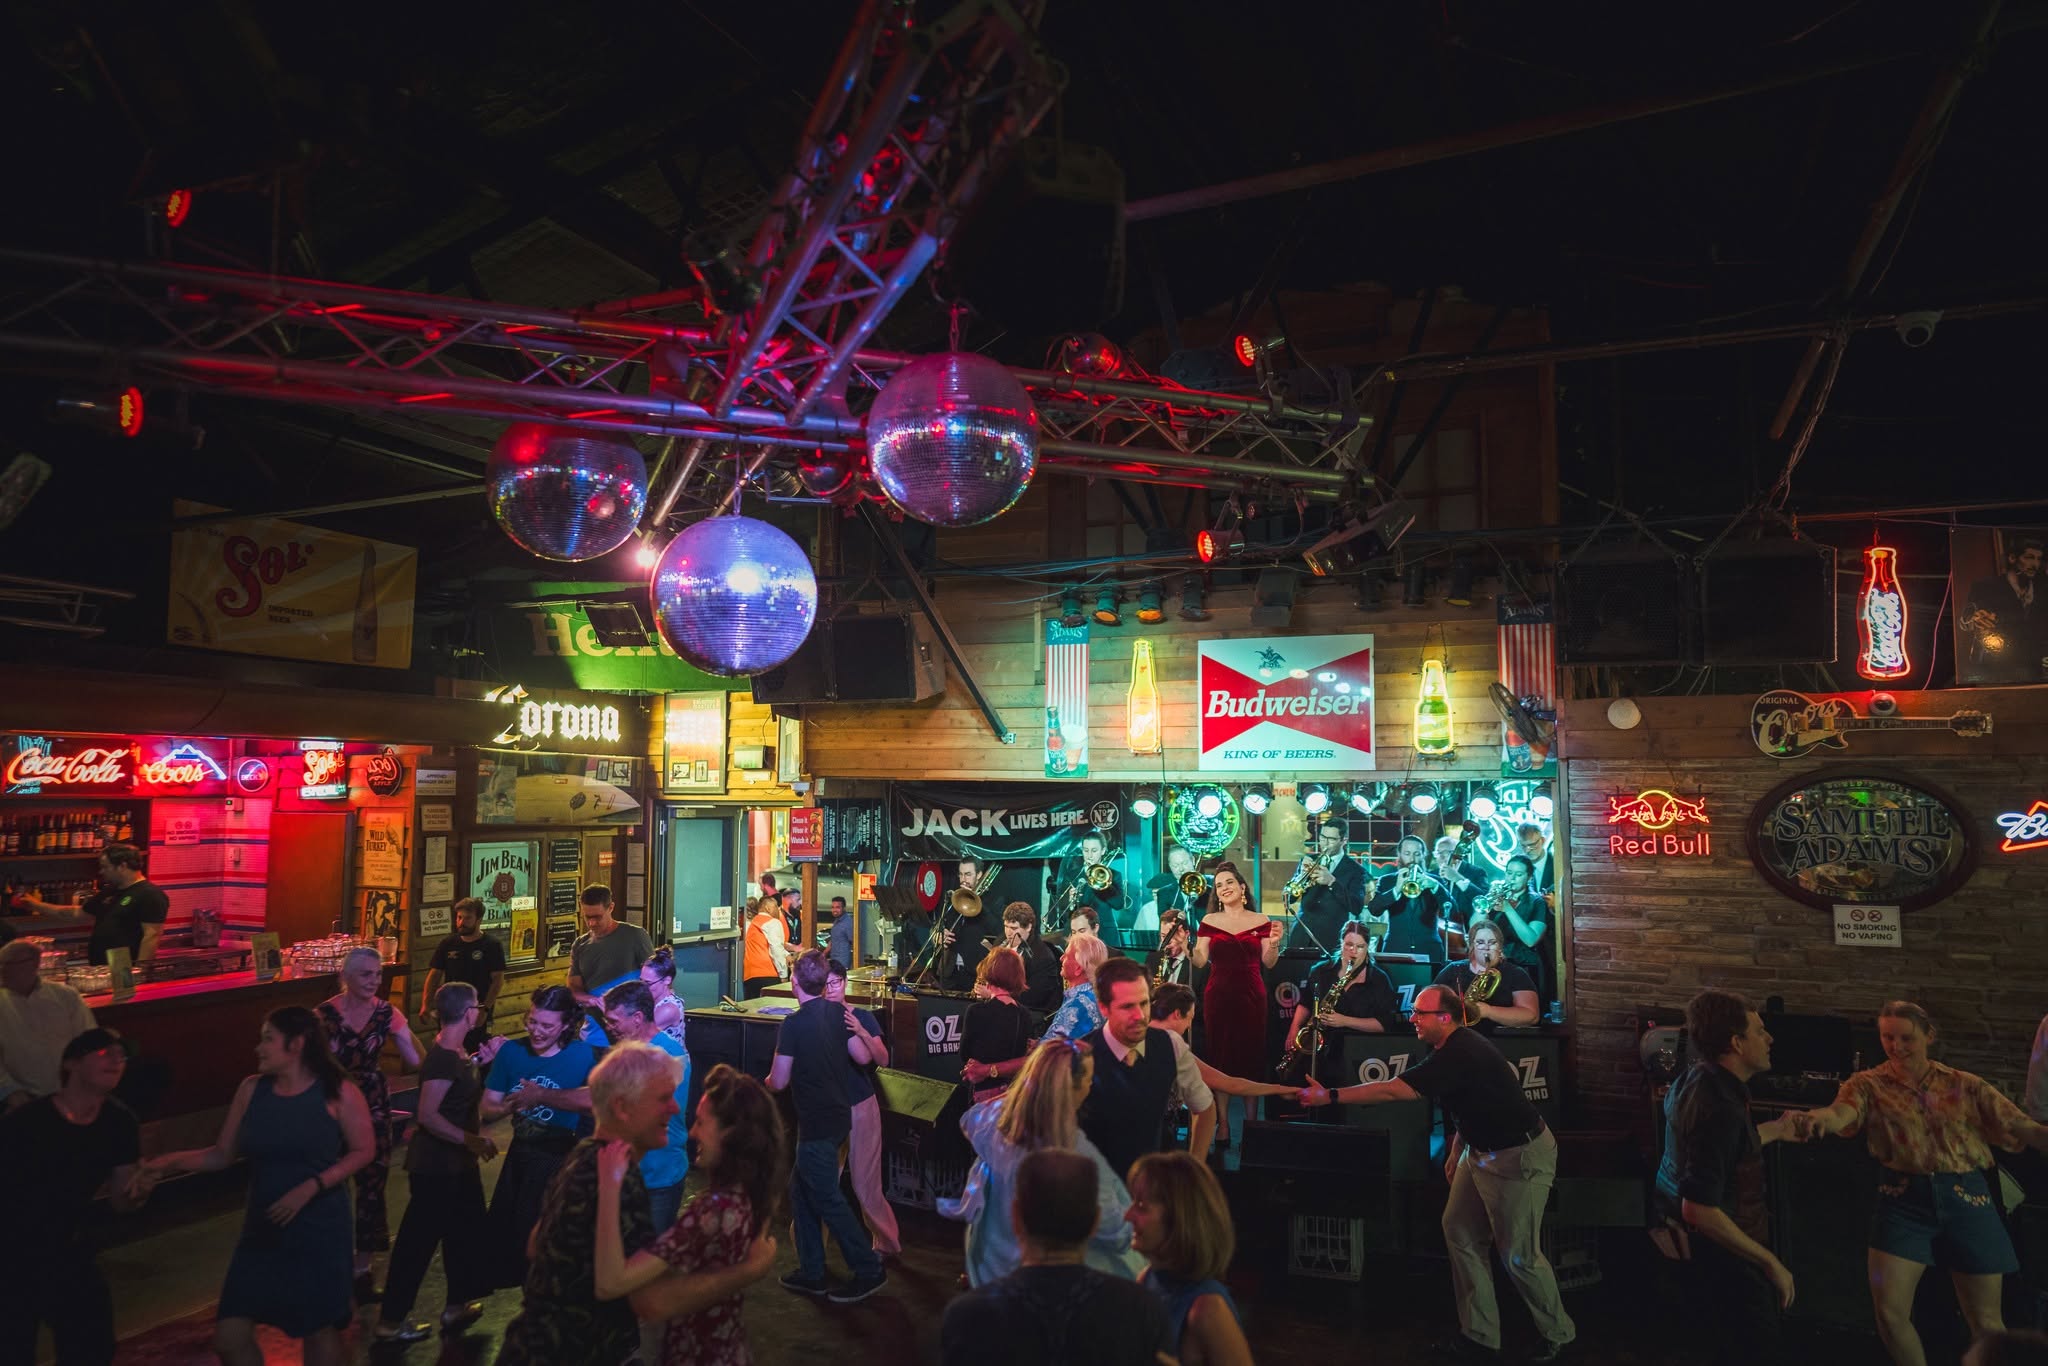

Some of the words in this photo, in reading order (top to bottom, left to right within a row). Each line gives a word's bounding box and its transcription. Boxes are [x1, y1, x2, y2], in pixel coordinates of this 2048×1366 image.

[1051, 627, 1083, 640] ADAMS
[1205, 687, 1367, 718] Budweiser
[1759, 697, 1799, 705] ORIGINAL
[7, 747, 129, 784] Coca-Cola
[1224, 749, 1258, 759] KING
[1262, 749, 1281, 759] OF
[144, 760, 204, 784] Coors
[902, 808, 1010, 837] JACK
[1010, 813, 1047, 830] LIVES
[1051, 809, 1089, 827] HERE.
[1774, 798, 1952, 841] SAMUEL
[366, 840, 387, 851] TURKEY
[369, 829, 385, 841] WILD
[1609, 832, 1657, 855] Red
[1663, 833, 1710, 856] Bull
[476, 856, 499, 884] JIM
[501, 850, 532, 878] BEAM
[1787, 834, 1936, 879] ADAMS
[1853, 923, 1897, 932] SMOKING
[1858, 932, 1893, 941] VAPING
[925, 1014, 962, 1044] OZ
[928, 1043, 941, 1054] BIG
[943, 1042, 961, 1054] BAN
[1507, 1055, 1547, 1089] Z
[1524, 1087, 1549, 1101] AND
